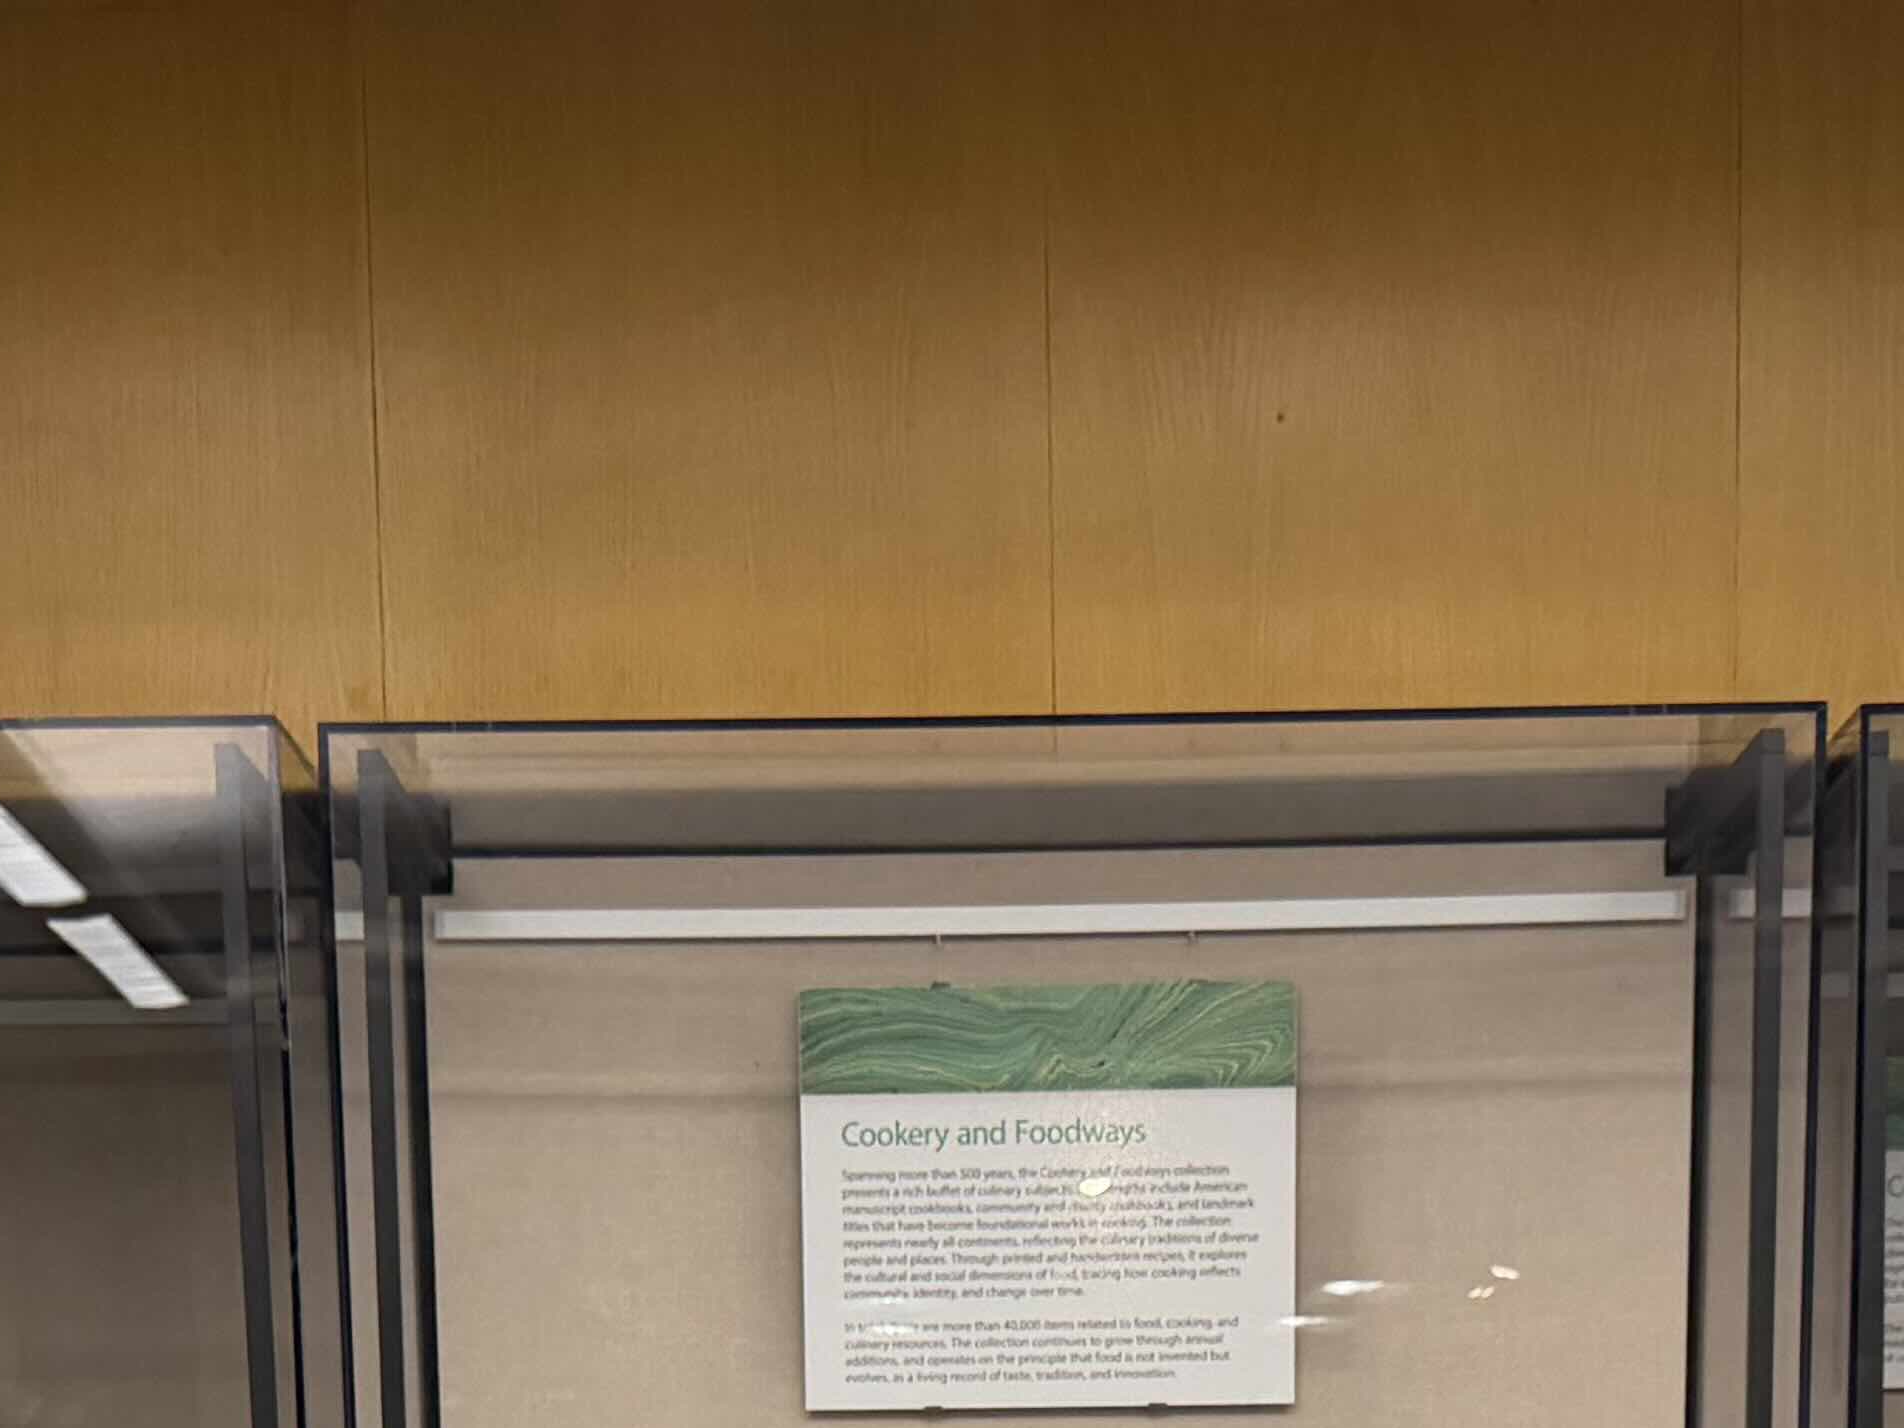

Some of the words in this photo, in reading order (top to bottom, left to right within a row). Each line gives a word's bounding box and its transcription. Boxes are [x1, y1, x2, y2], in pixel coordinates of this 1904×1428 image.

[841, 1120, 949, 1152] Cookery
[957, 1119, 1006, 1146] and
[1015, 1117, 1147, 1147] Foodways
